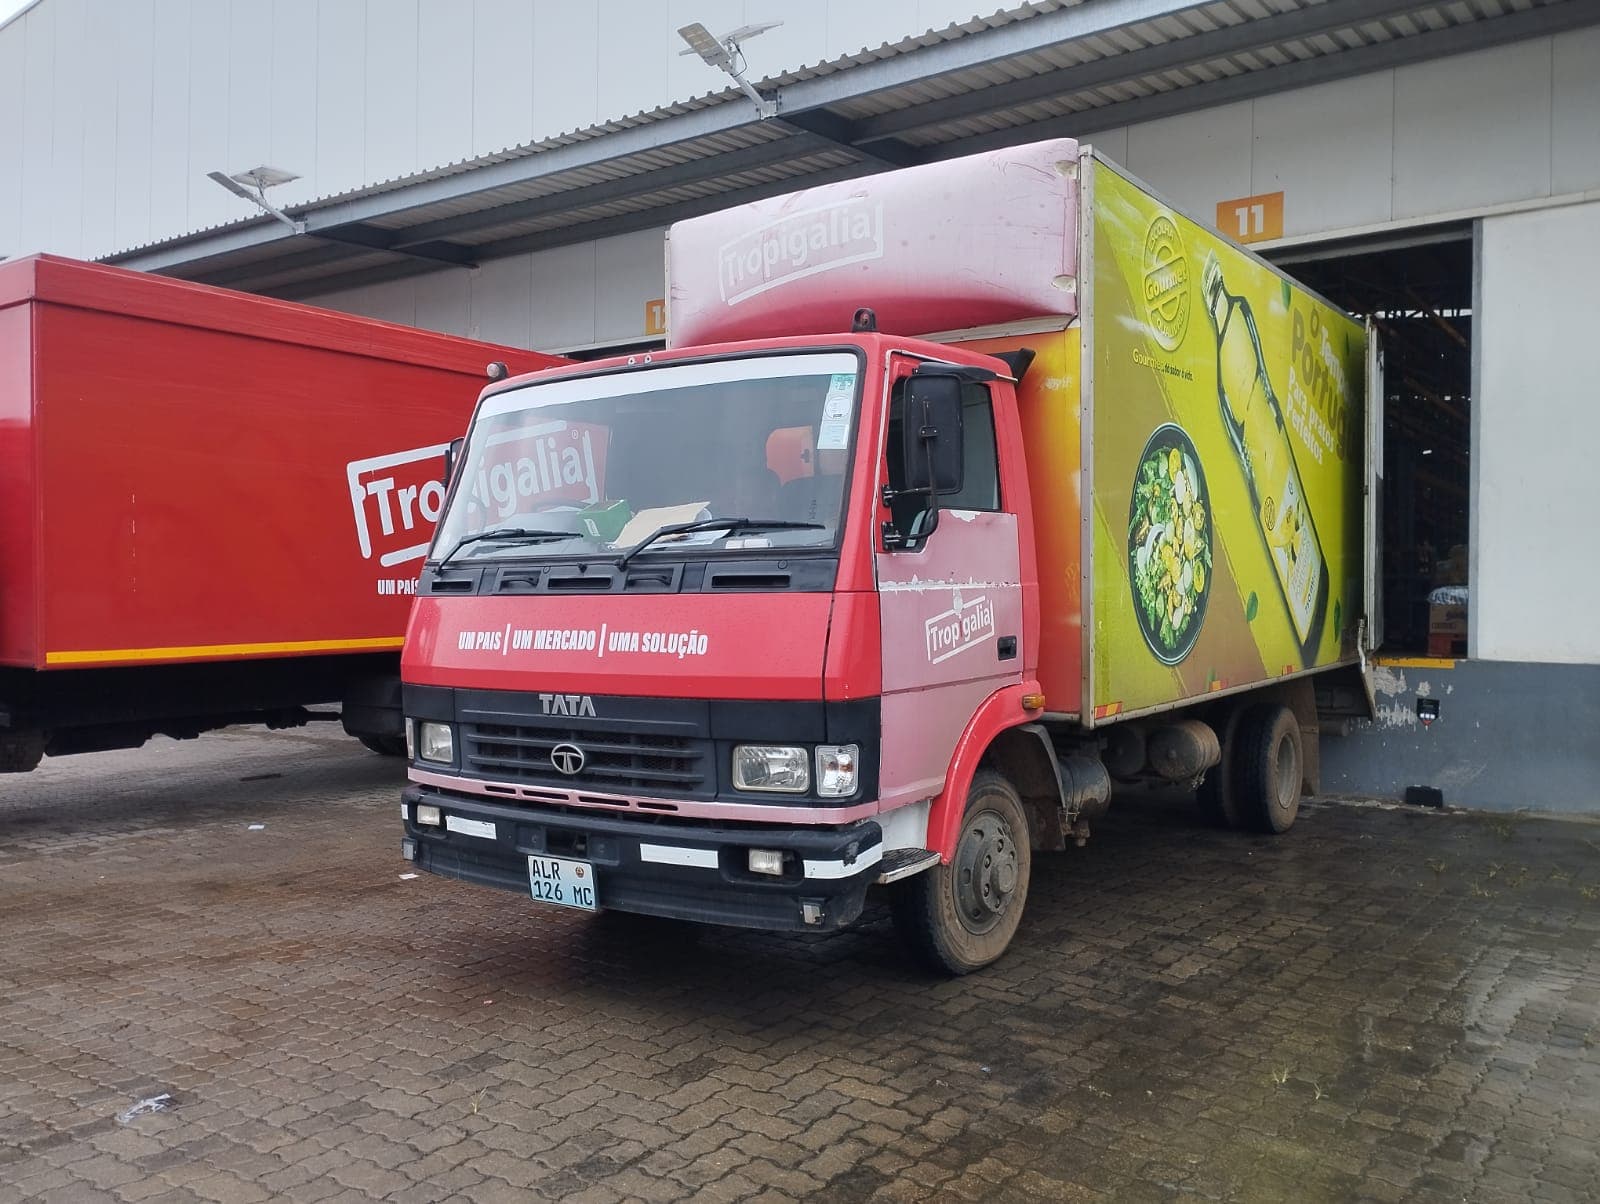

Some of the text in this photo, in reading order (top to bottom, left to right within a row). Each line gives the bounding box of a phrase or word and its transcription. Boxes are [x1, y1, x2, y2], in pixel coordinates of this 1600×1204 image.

[1235, 204, 1264, 237] 11
[725, 203, 872, 288] Tropigalia
[652, 305, 666, 329] 1
[1308, 405, 1335, 453] pratos
[377, 579, 396, 595] UM
[458, 631, 476, 650] UM
[512, 629, 533, 650] UM
[533, 630, 597, 651] MERCADO
[608, 632, 639, 652] UMA
[641, 629, 709, 659] SOLUÇÃO
[538, 694, 597, 717] TATA
[532, 859, 561, 880] ALR
[533, 881, 593, 906] 126 MC
